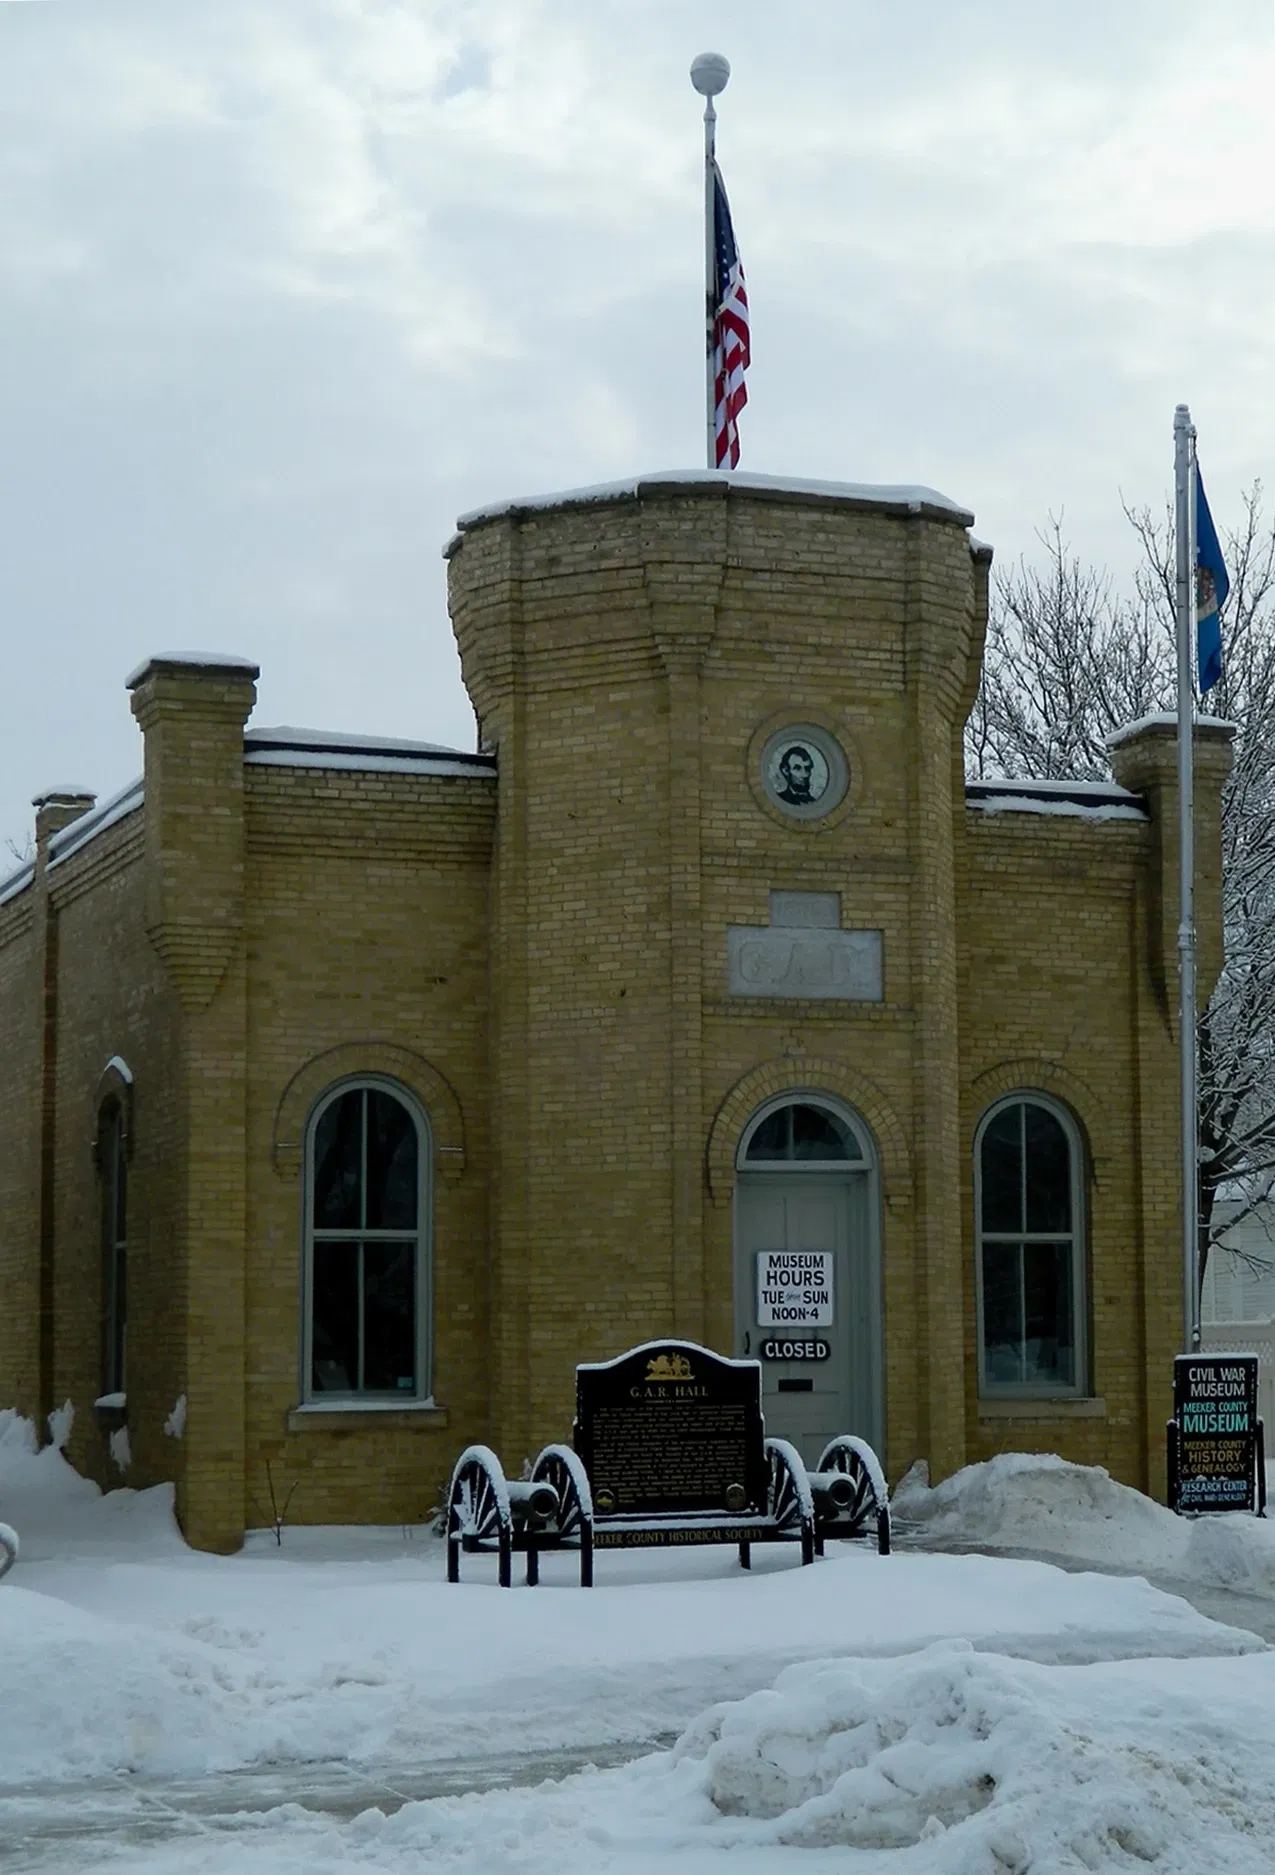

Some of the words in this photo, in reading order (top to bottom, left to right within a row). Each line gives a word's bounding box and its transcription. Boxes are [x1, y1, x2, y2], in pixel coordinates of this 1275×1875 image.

[769, 1255, 824, 1268] MUSEUM
[766, 1270, 825, 1286] HOURS
[762, 1291, 785, 1304] TUE
[803, 1291, 828, 1304] SUN
[765, 1343, 827, 1357] CLOSED
[1189, 1367, 1217, 1381] CIVIL
[1220, 1367, 1246, 1381] WAR
[675, 1386, 709, 1397] HALL
[1191, 1383, 1245, 1396] MUSEUM
[1183, 1402, 1216, 1413] MEEKER
[1219, 1401, 1248, 1412] COUNTY
[1183, 1414, 1249, 1433] MUSEUM
[1184, 1441, 1216, 1450] MEEKER
[1218, 1440, 1247, 1449] COUNTY
[1189, 1450, 1241, 1463] HISTORY
[1191, 1463, 1246, 1474] GENEALOGY
[626, 1532, 665, 1545] COUNTY
[669, 1530, 722, 1542] HISTORICAL
[725, 1528, 763, 1540] SOCIETY
